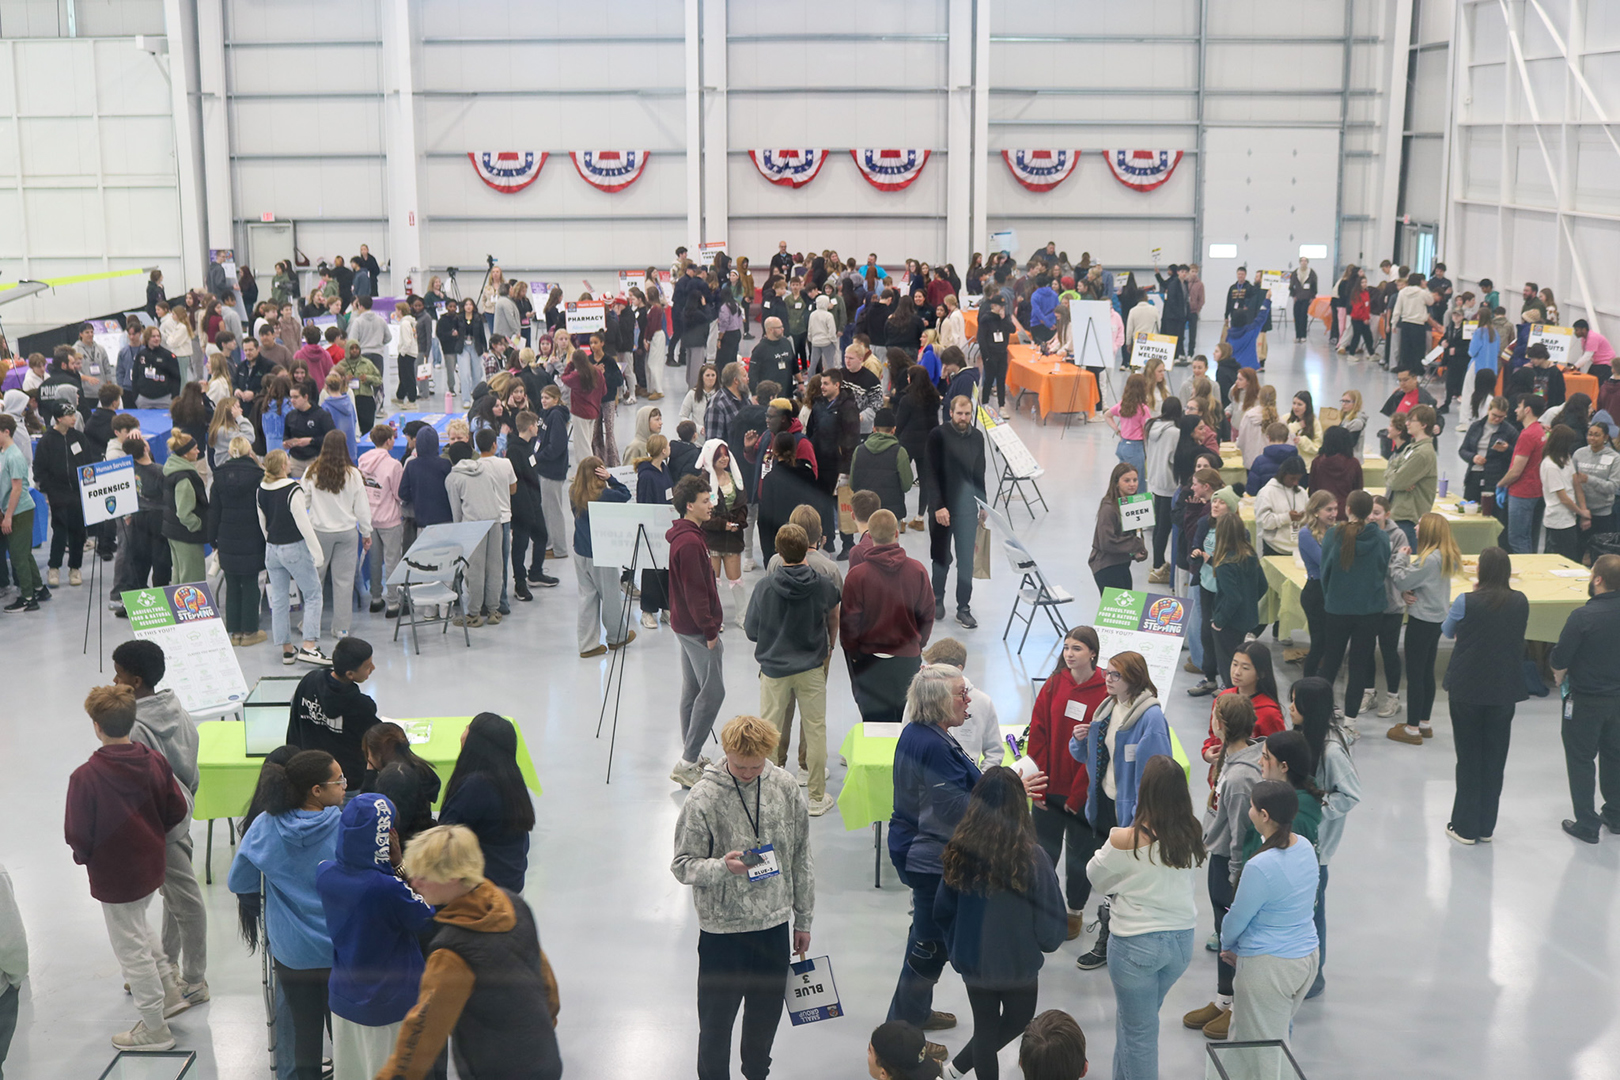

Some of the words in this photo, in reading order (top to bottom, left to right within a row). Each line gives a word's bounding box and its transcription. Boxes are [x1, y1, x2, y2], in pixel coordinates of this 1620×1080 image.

[1140, 346, 1168, 354] VIRTUAL
[1138, 352, 1168, 360] WELDING
[96, 465, 112, 474] Human
[112, 460, 132, 470] Services
[88, 482, 130, 498] FORENSICS
[1125, 508, 1150, 516] GREEN
[132, 606, 166, 615] AGRICULTURE,
[1103, 606, 1137, 615] AGRICULTURE,
[140, 618, 167, 626] RESOURCES
[754, 868, 773, 876] BLUE-3
[802, 974, 810, 984] 3
[794, 984, 824, 998] BLUE
[799, 1008, 819, 1018] GROUP
[800, 1014, 820, 1022] SMALL
